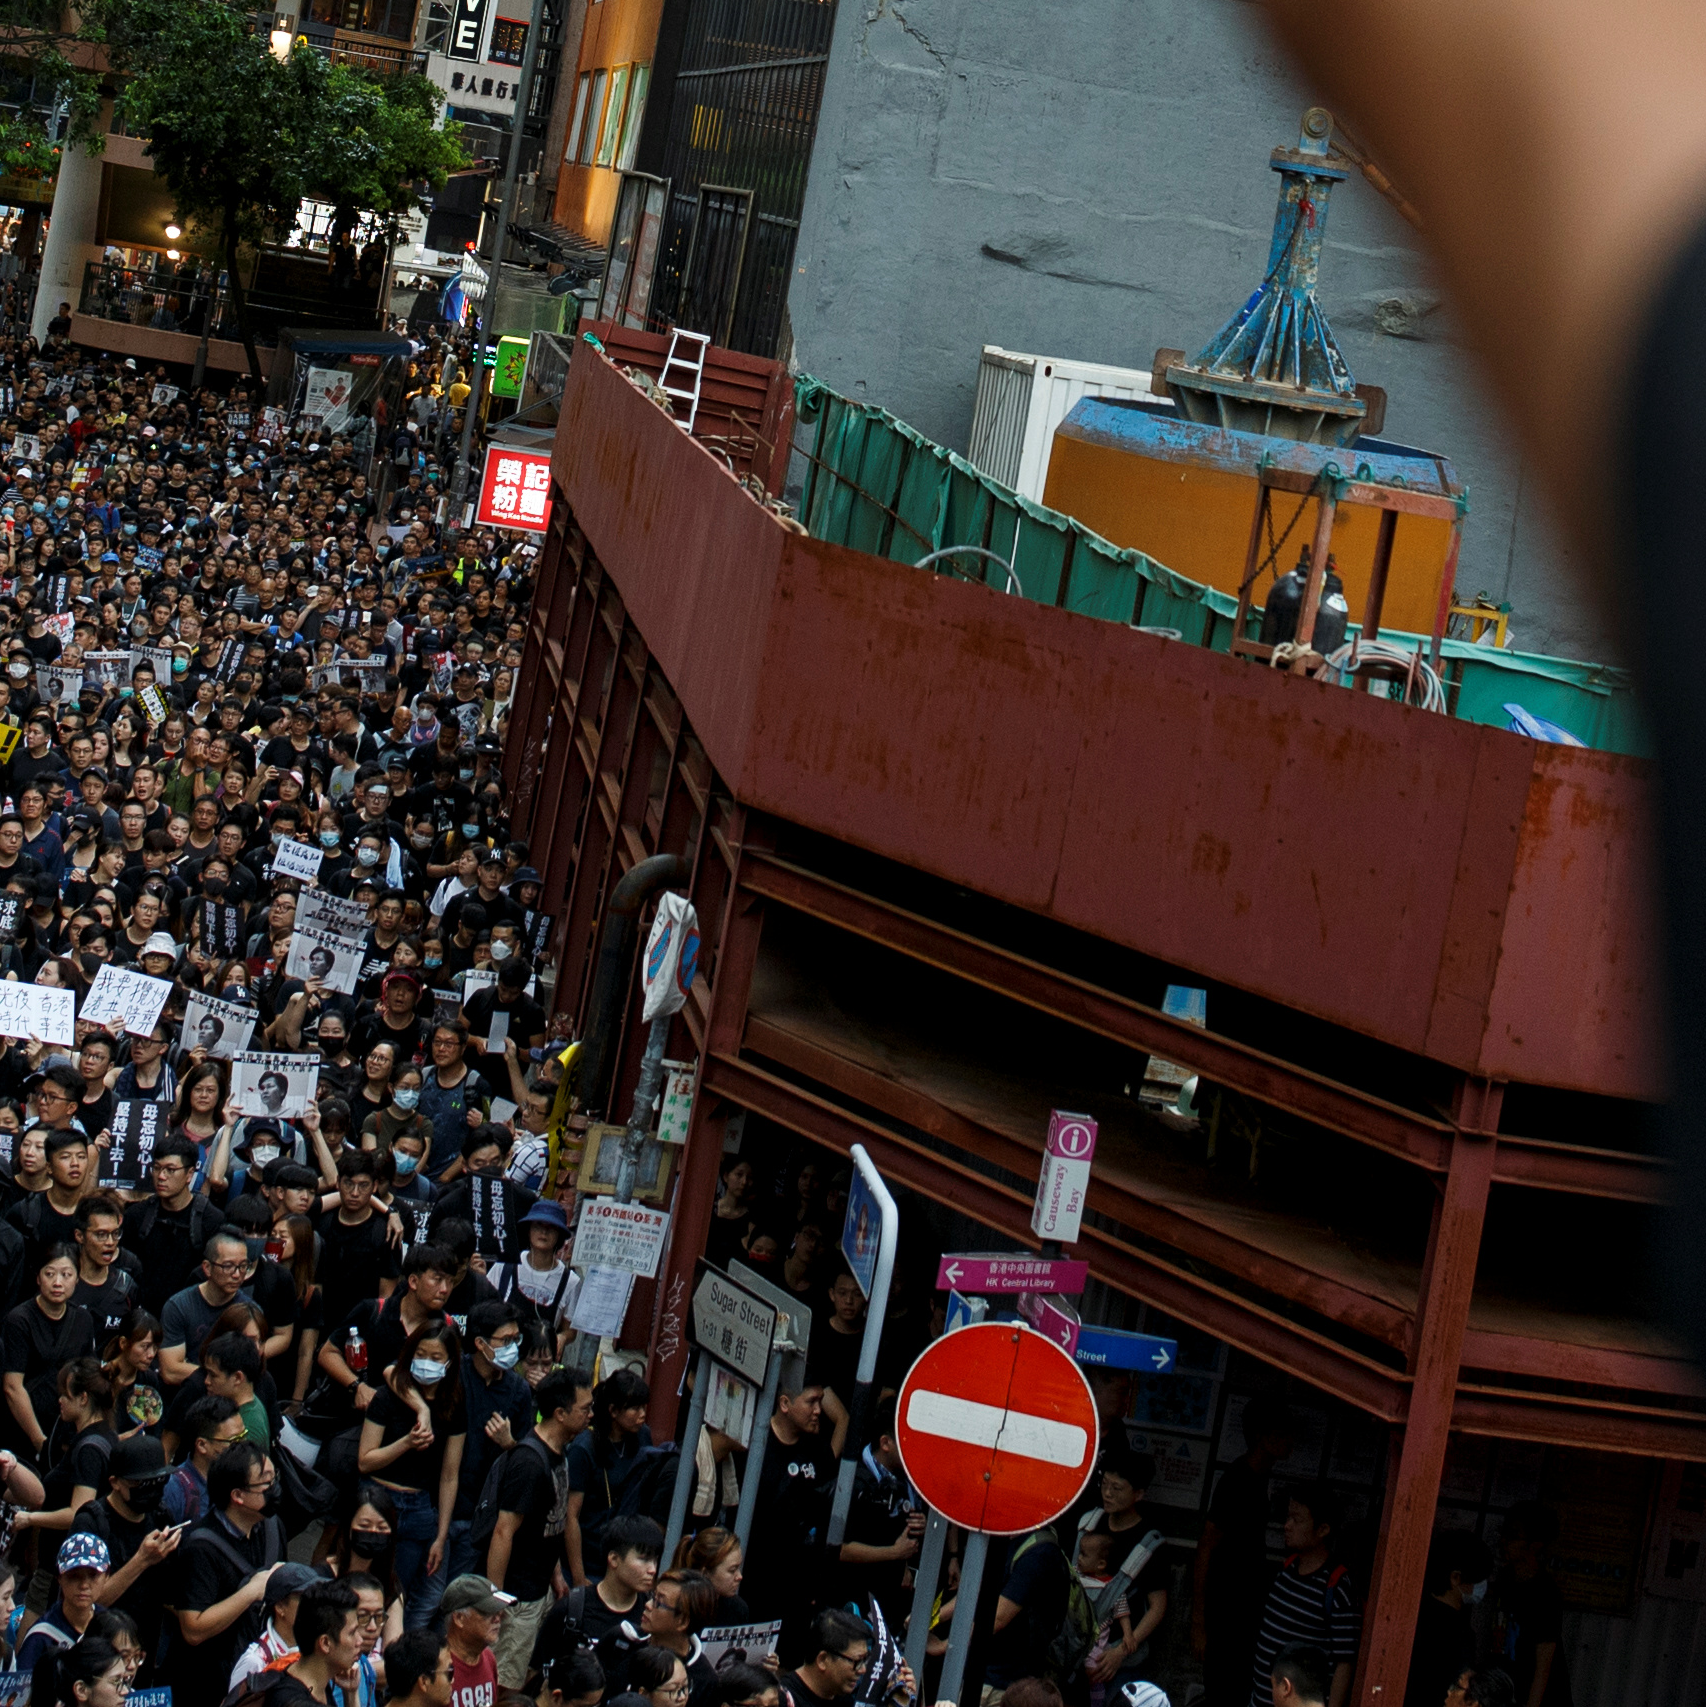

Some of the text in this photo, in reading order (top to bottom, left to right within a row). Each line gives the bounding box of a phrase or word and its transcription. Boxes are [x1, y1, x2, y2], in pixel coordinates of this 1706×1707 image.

[496, 458, 550, 490] 榮記
[261, 614, 274, 624] 49
[110, 1101, 131, 1176] 堅持下去！
[137, 1104, 158, 1179] 毋忘初心！
[1044, 1163, 1068, 1233] Causeway
[1066, 1188, 1083, 1214] Bay
[490, 1180, 507, 1253] 毋忘初心！
[986, 1278, 1056, 1290] HK Central Library
[989, 1262, 1052, 1275] 香港中央圖書館
[710, 1282, 771, 1337] Sugar Street
[721, 1325, 748, 1365] 糖街
[1076, 1348, 1107, 1363] Street
